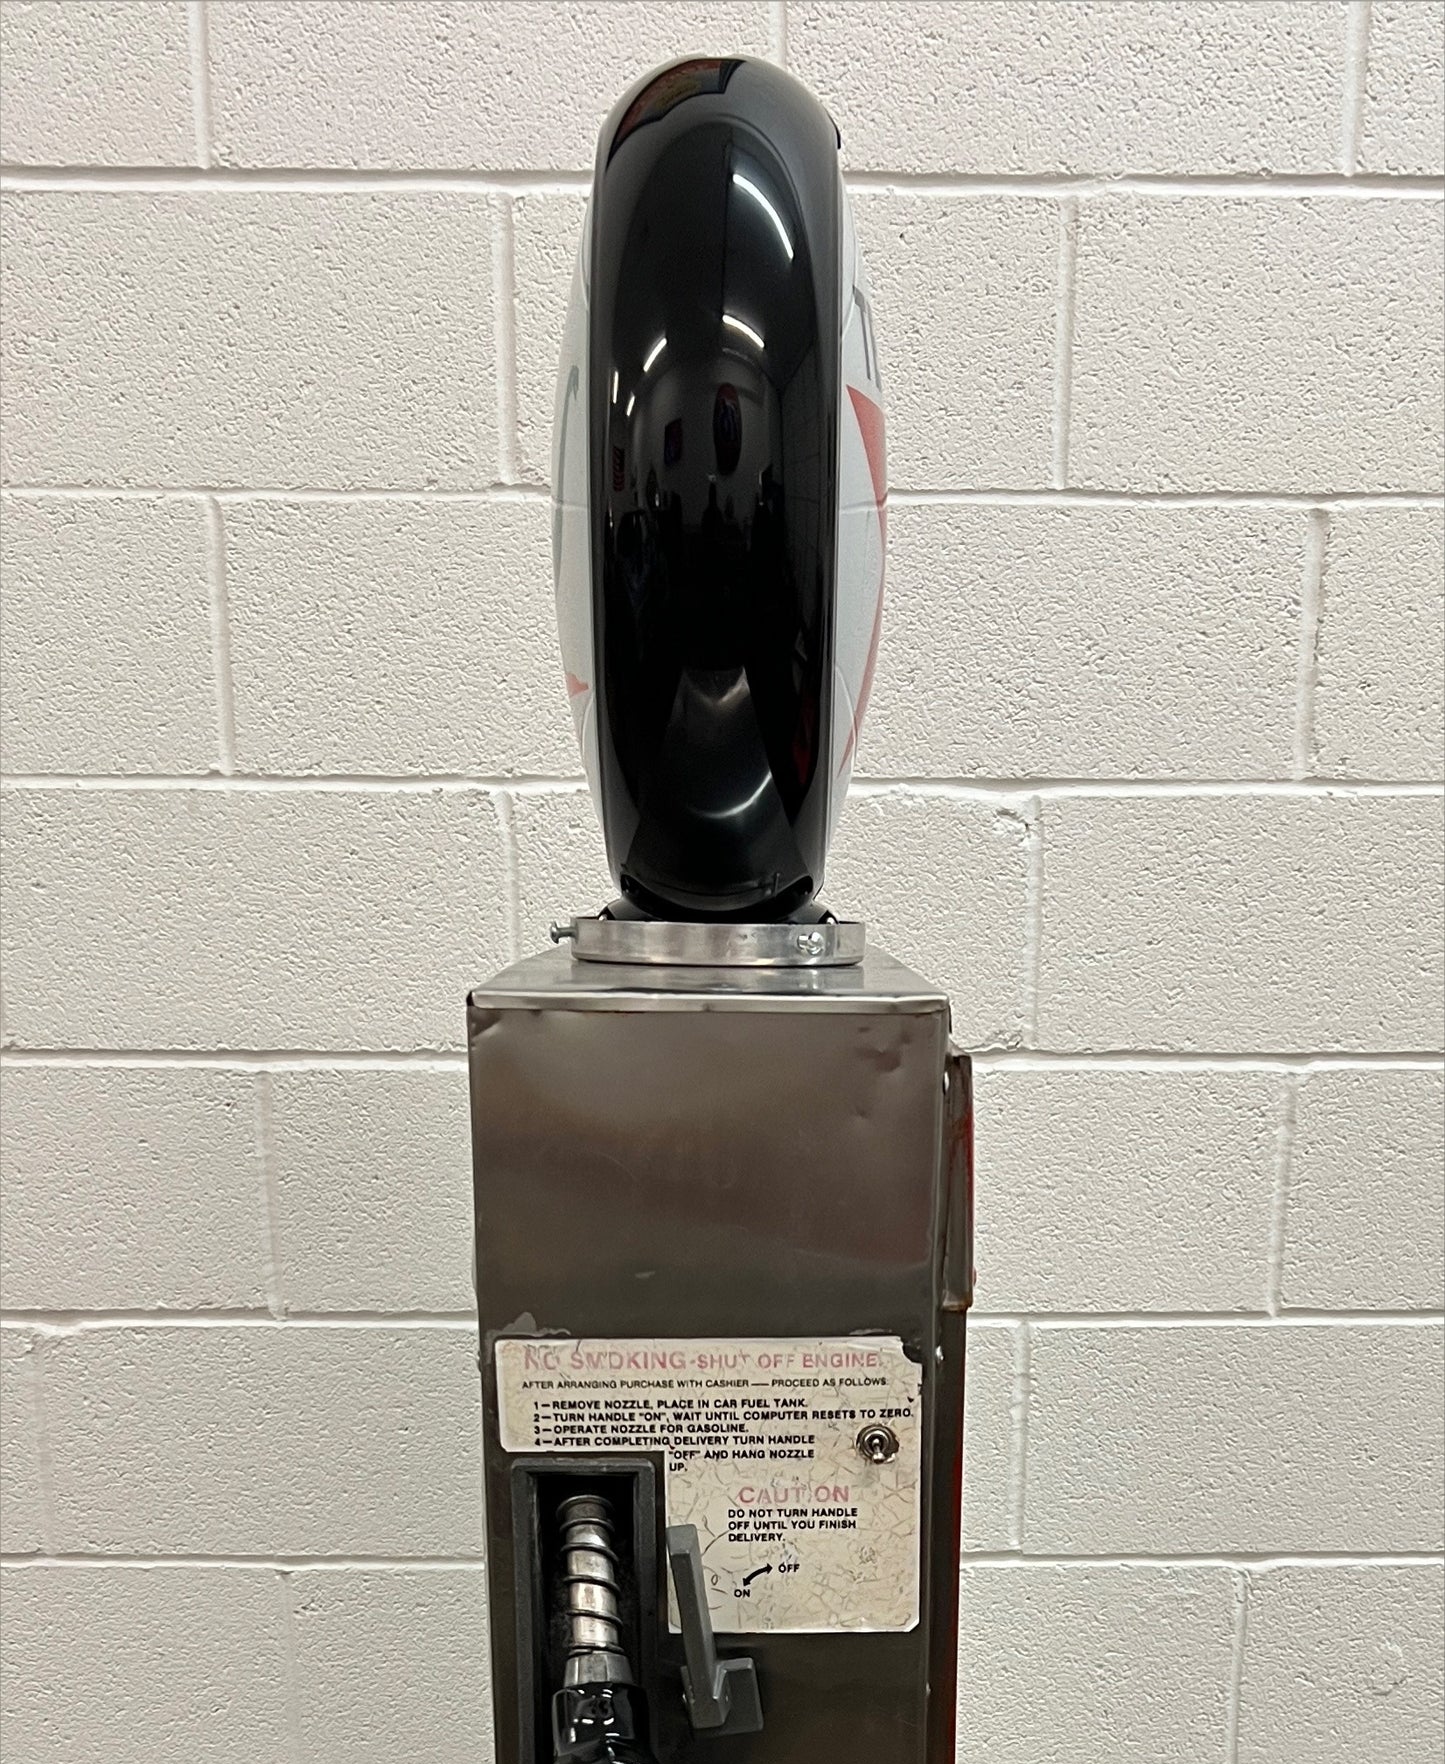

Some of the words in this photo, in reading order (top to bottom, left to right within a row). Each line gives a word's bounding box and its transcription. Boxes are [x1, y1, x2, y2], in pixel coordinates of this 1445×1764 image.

[757, 1353, 795, 1369] OFF
[522, 1380, 554, 1389] AFTER
[557, 1379, 617, 1389] ARRANGING
[620, 1379, 674, 1388] PURCHASE
[677, 1379, 702, 1388] WITH
[705, 1379, 749, 1388] CASHIER
[771, 1378, 820, 1388] PROCEED
[822, 1378, 836, 1387] AS
[657, 1400, 694, 1410] PLACE
[698, 1400, 710, 1409] IN
[714, 1399, 738, 1409] CAR
[741, 1399, 770, 1409] FUEL
[774, 1398, 808, 1408] TANK.
[588, 1412, 635, 1422] HANDLE
[673, 1412, 701, 1421] WAIT
[705, 1411, 739, 1421] UNTIL
[743, 1410, 808, 1421] COMPUTER
[812, 1410, 856, 1419] RESETS
[859, 1409, 876, 1419] TO
[611, 1424, 656, 1434] NOZZLE
[660, 1424, 684, 1433] FOR
[687, 1423, 749, 1433] GASOLINE.
[594, 1436, 670, 1446] COMPLETING
[674, 1435, 729, 1446] DELIVERY
[734, 1435, 764, 1445] TURN
[768, 1435, 815, 1445] HANDLE
[704, 1450, 728, 1459] AND
[732, 1449, 766, 1459] HANG
[769, 1449, 815, 1459] NOZZLE
[728, 1509, 745, 1518] DO
[749, 1509, 773, 1518] NOT
[777, 1508, 808, 1518] TURN
[811, 1507, 858, 1517] HANDLE
[728, 1521, 750, 1531] OFF
[753, 1521, 787, 1530] UNTIL
[791, 1520, 815, 1529] YOU
[818, 1520, 857, 1529] FINISH
[728, 1533, 786, 1542] DELIVERY.
[778, 1563, 800, 1573] OFF
[733, 1588, 751, 1598] ON
